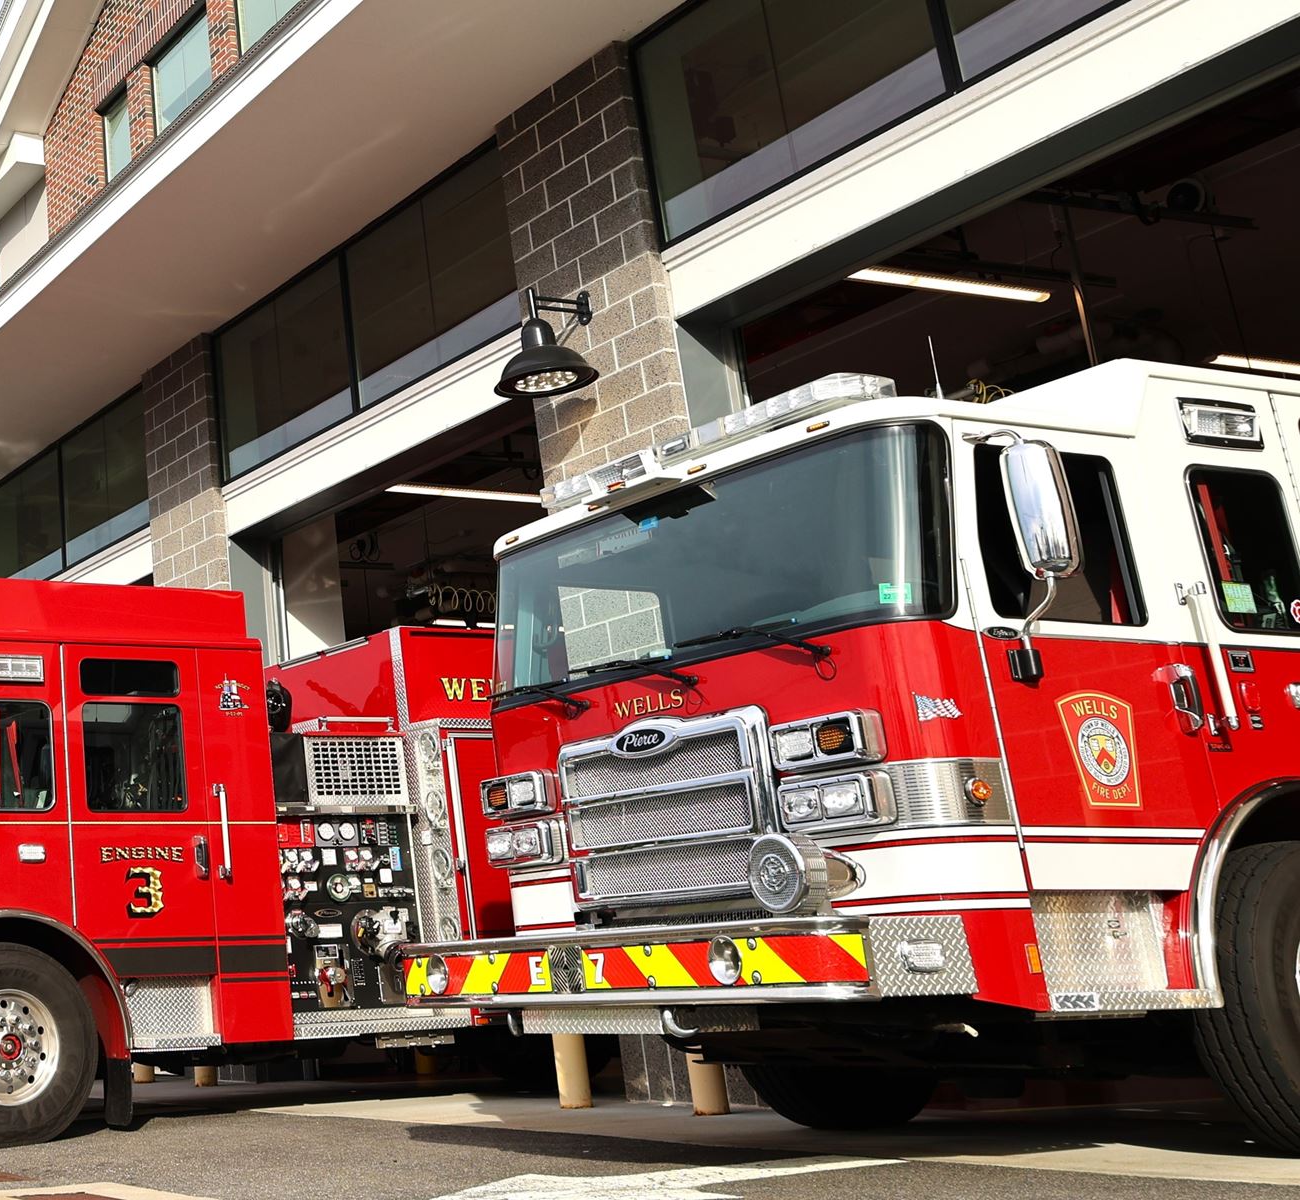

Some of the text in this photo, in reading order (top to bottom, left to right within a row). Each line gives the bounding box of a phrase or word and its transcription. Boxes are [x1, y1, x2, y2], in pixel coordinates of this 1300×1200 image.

[614, 688, 684, 719] WELLS
[1071, 700, 1118, 720] WELLS
[623, 733, 659, 752] Pierce
[1092, 782, 1110, 799] FIRE
[100, 846, 184, 863] ENGINE
[126, 867, 165, 918] 3
[528, 953, 605, 985] E 7
